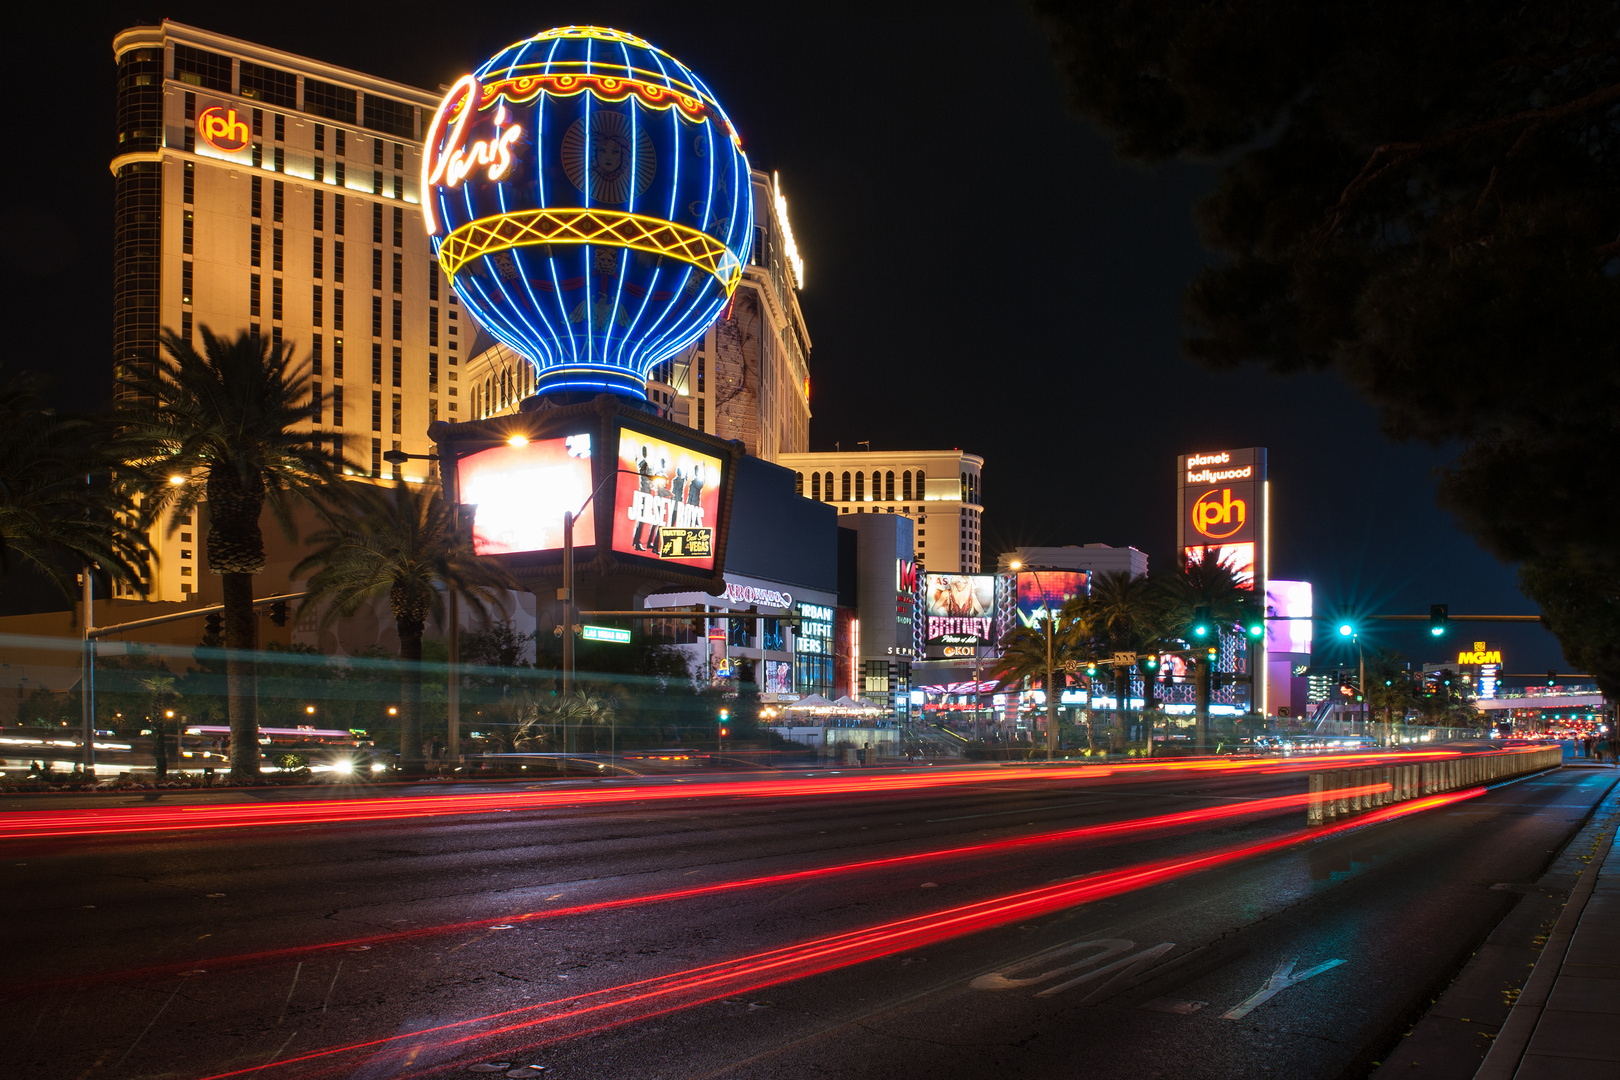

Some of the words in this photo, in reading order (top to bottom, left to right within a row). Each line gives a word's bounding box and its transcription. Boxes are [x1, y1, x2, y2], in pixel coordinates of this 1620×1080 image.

[205, 109, 249, 143] ph
[420, 74, 522, 236] Paris
[1187, 452, 1230, 470] planet
[1187, 465, 1252, 484] hollywood
[1199, 488, 1246, 532] ph
[689, 541, 709, 552] VEGAS
[896, 558, 916, 594] M
[585, 629, 597, 637] LAS
[597, 630, 615, 639] VEGAS
[615, 632, 628, 640] BLVD
[801, 621, 832, 637] UTFIT
[928, 615, 992, 640] BRITNEY
[954, 646, 975, 656] KOI
[1458, 651, 1502, 665] MGM
